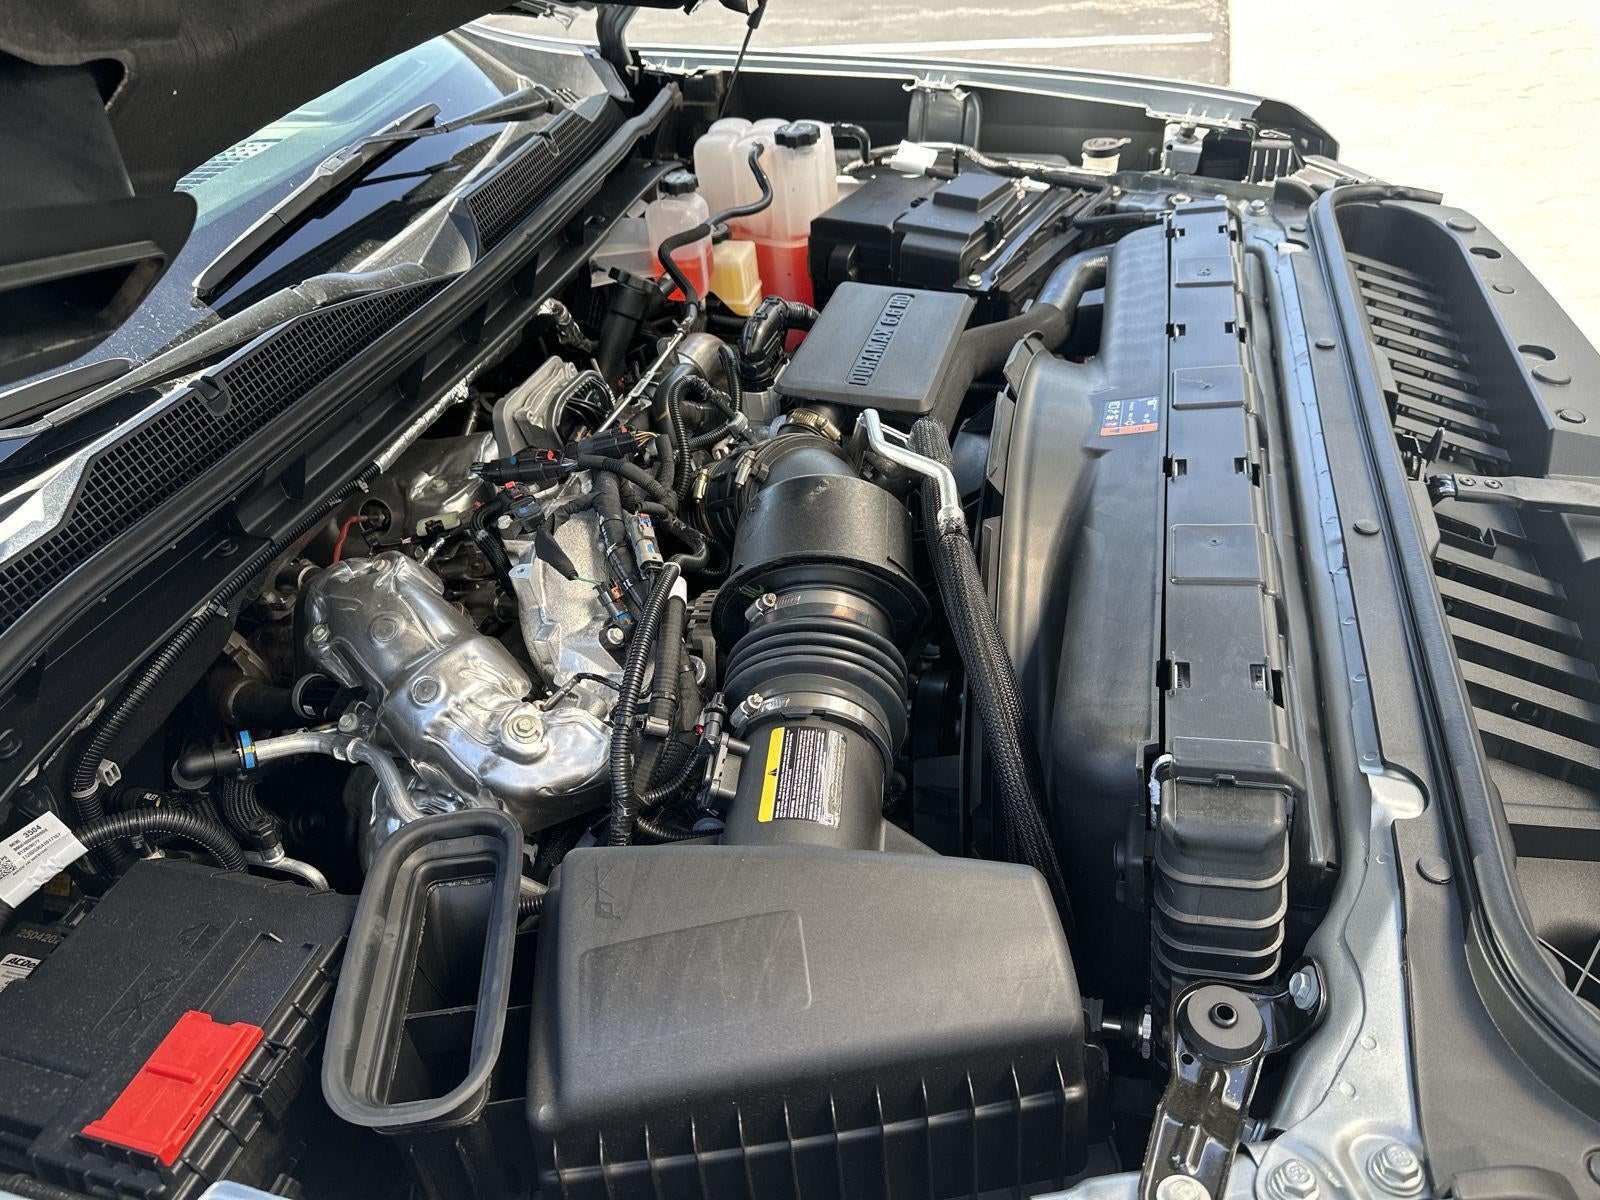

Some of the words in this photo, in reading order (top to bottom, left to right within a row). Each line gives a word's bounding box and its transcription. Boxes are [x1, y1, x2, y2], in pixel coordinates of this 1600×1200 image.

[848, 328, 894, 386] DURAMAX
[889, 295, 911, 309] HD
[22, 824, 42, 839] 3504
[6, 957, 37, 968] ACDe
